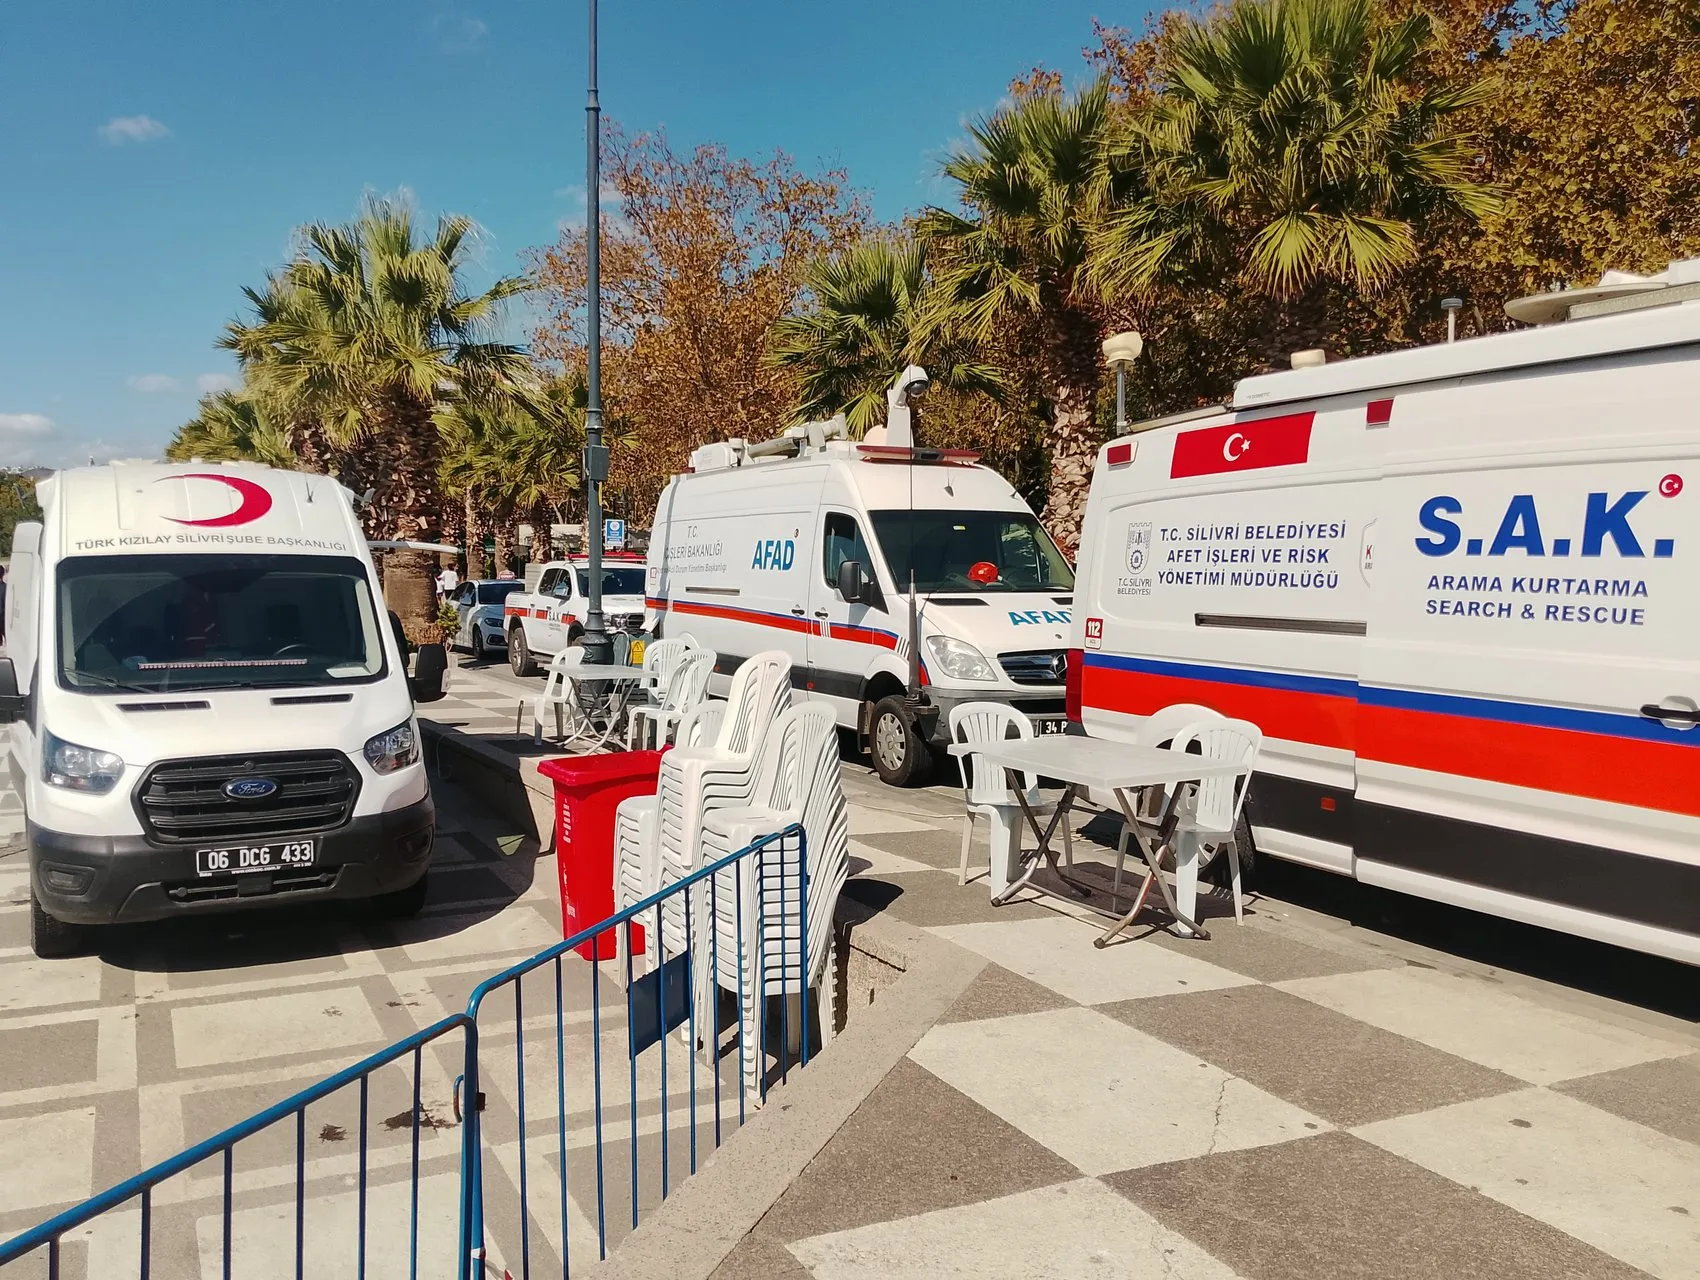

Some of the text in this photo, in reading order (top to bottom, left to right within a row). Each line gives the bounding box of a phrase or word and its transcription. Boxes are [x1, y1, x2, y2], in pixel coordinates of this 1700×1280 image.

[1160, 520, 1346, 542] T.C. SİLİVRİ BELEDİYESİ
[1415, 491, 1675, 558] S.A.K.
[75, 533, 347, 552] TÜRK KIZILAY SİLİVRİ ŞUBE BAŞKANLIĞI
[752, 540, 795, 571] AFAD
[1166, 545, 1330, 567] AFET İŞLERİ VE RİSK
[1158, 568, 1339, 589] YÖNETİMİ MÜDÜRLÜĞÜ
[1427, 575, 1649, 598] ARAMA KURTARMA
[1426, 600, 1645, 626] SEARCH & RESCUE
[1088, 621, 1101, 637] 112
[1046, 721, 1058, 734] 34
[239, 783, 266, 794] Ford
[208, 844, 311, 870] 06 DCG 433
